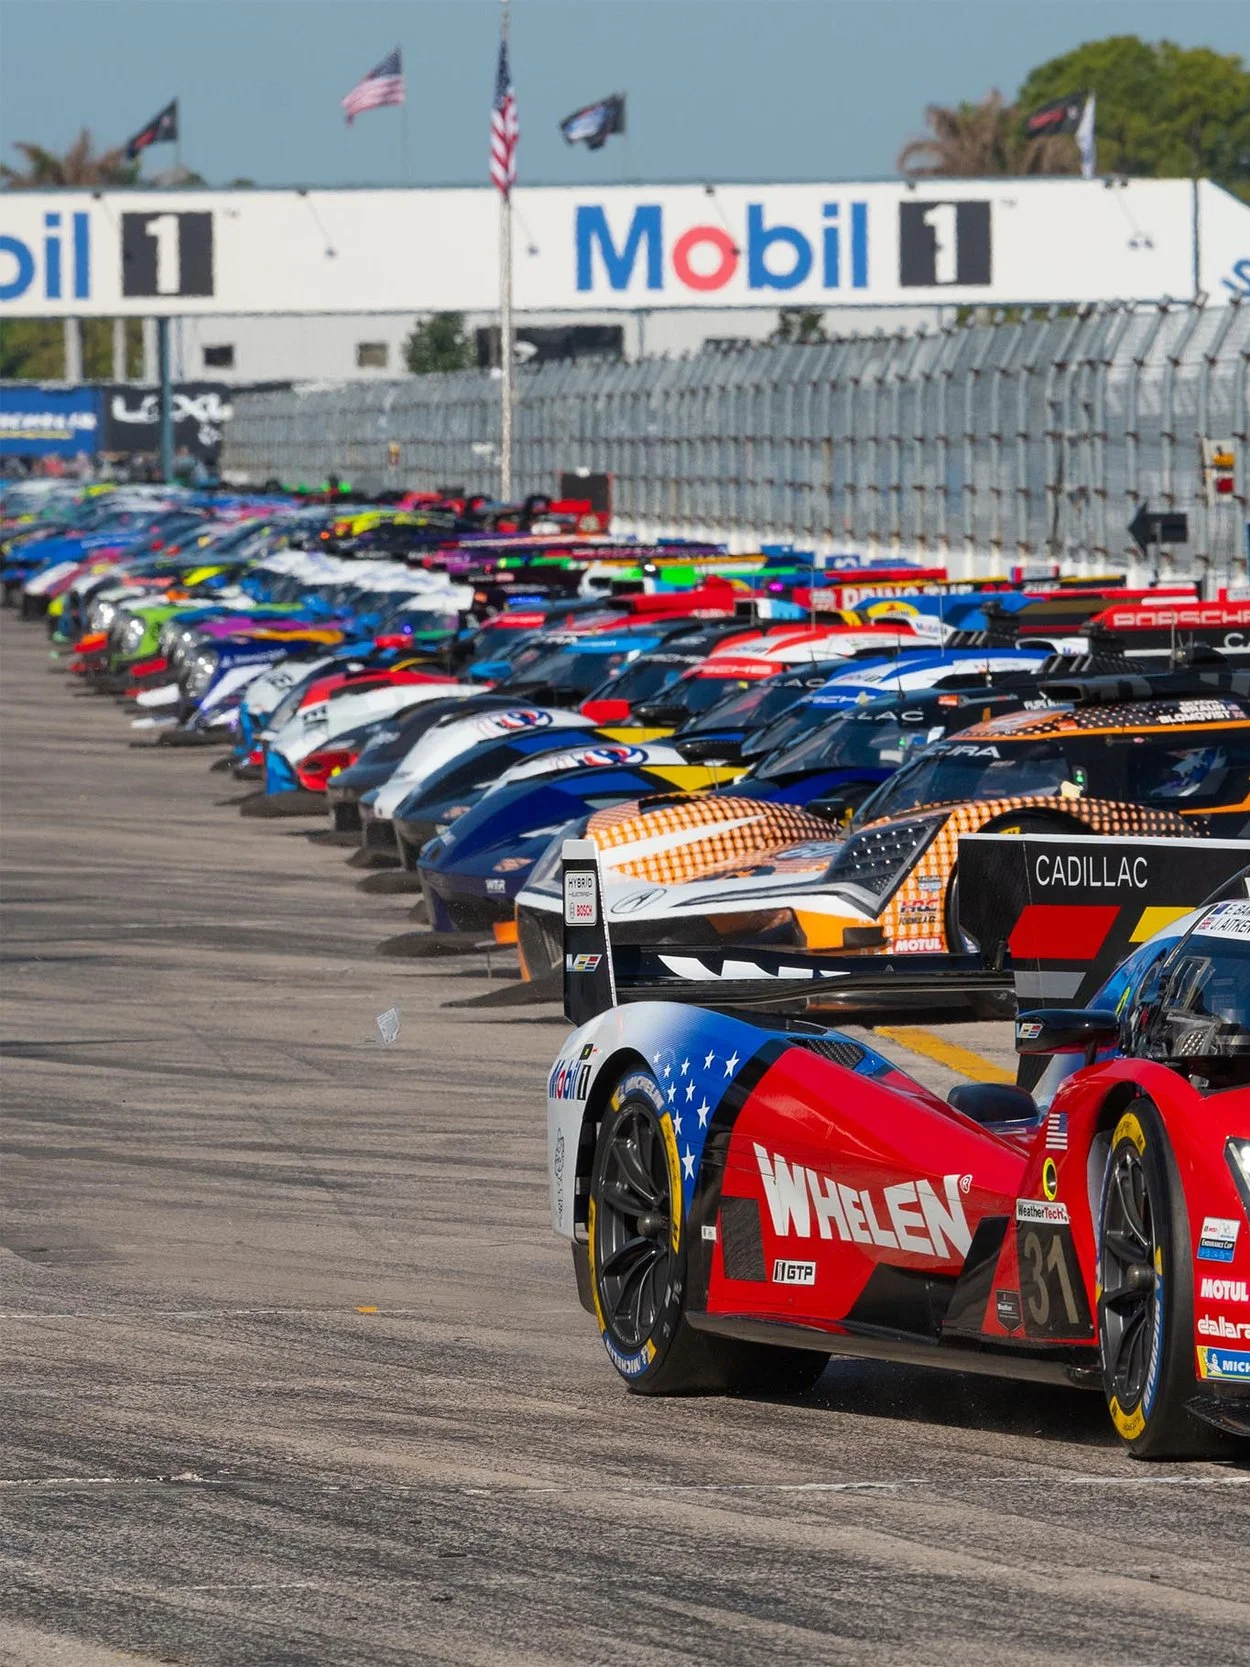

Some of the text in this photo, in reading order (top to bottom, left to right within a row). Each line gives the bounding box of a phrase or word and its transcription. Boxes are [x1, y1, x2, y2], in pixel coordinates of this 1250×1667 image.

[575, 202, 869, 291] Mobil
[1158, 711, 1230, 724] BLOMQVIST
[1035, 855, 1149, 888] CADILLAC
[576, 904, 593, 917] BOSCH
[895, 937, 942, 952] MOTUL
[549, 1058, 582, 1100] Mobil
[1018, 1203, 1065, 1220] WeatherTech
[786, 1264, 813, 1281] GTP
[1024, 1232, 1079, 1325] 31
[1201, 1278, 1249, 1302] MOTUL
[605, 1338, 641, 1374] MICHELIN
